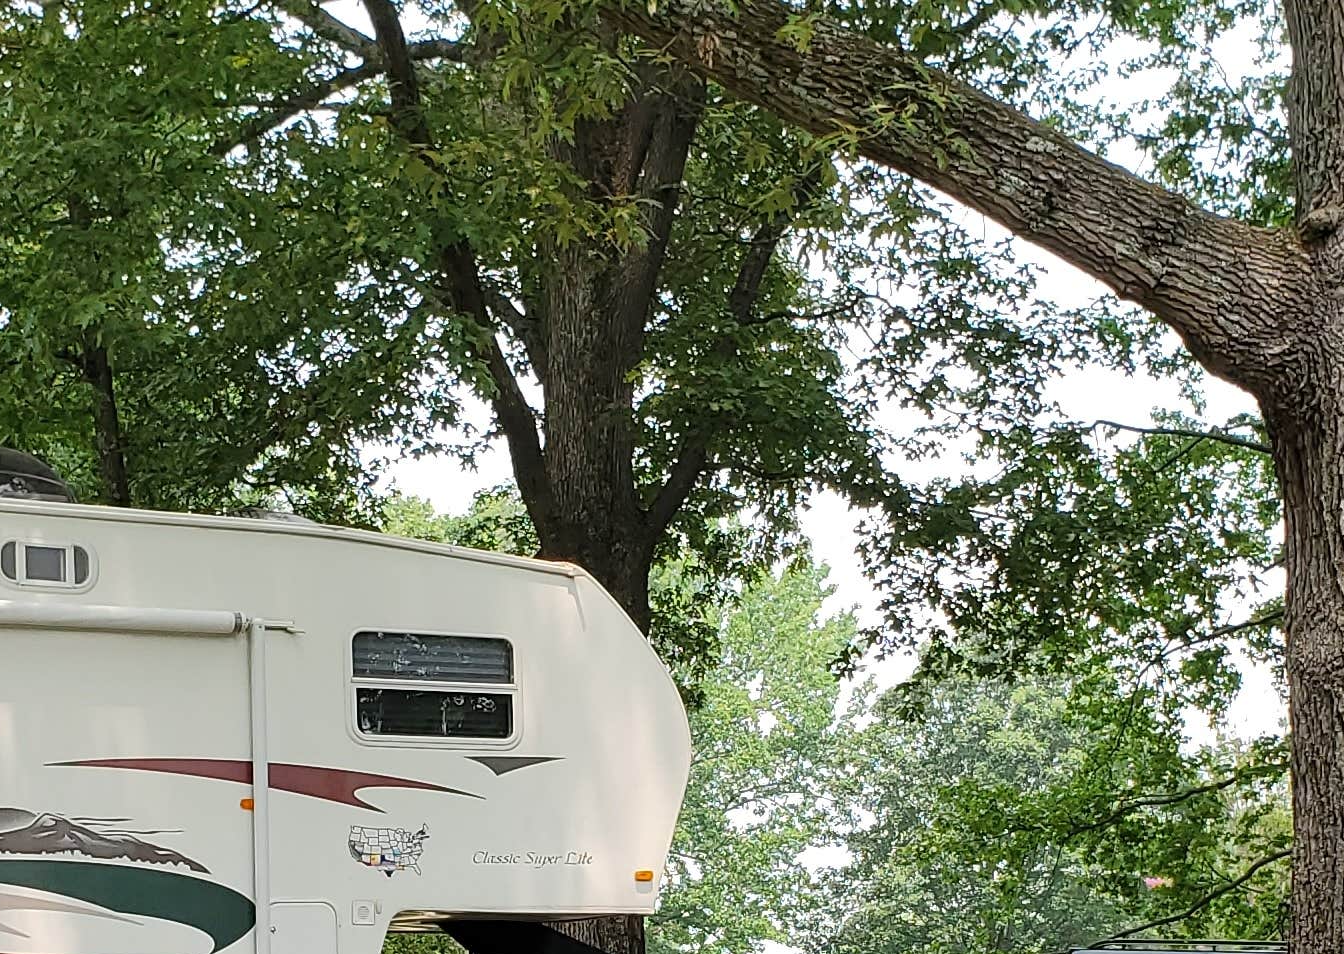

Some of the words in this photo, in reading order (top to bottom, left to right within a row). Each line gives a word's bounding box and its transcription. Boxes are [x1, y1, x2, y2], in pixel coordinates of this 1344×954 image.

[472, 850, 521, 865] Classic
[524, 851, 562, 869] Super
[564, 851, 593, 866] Lite
